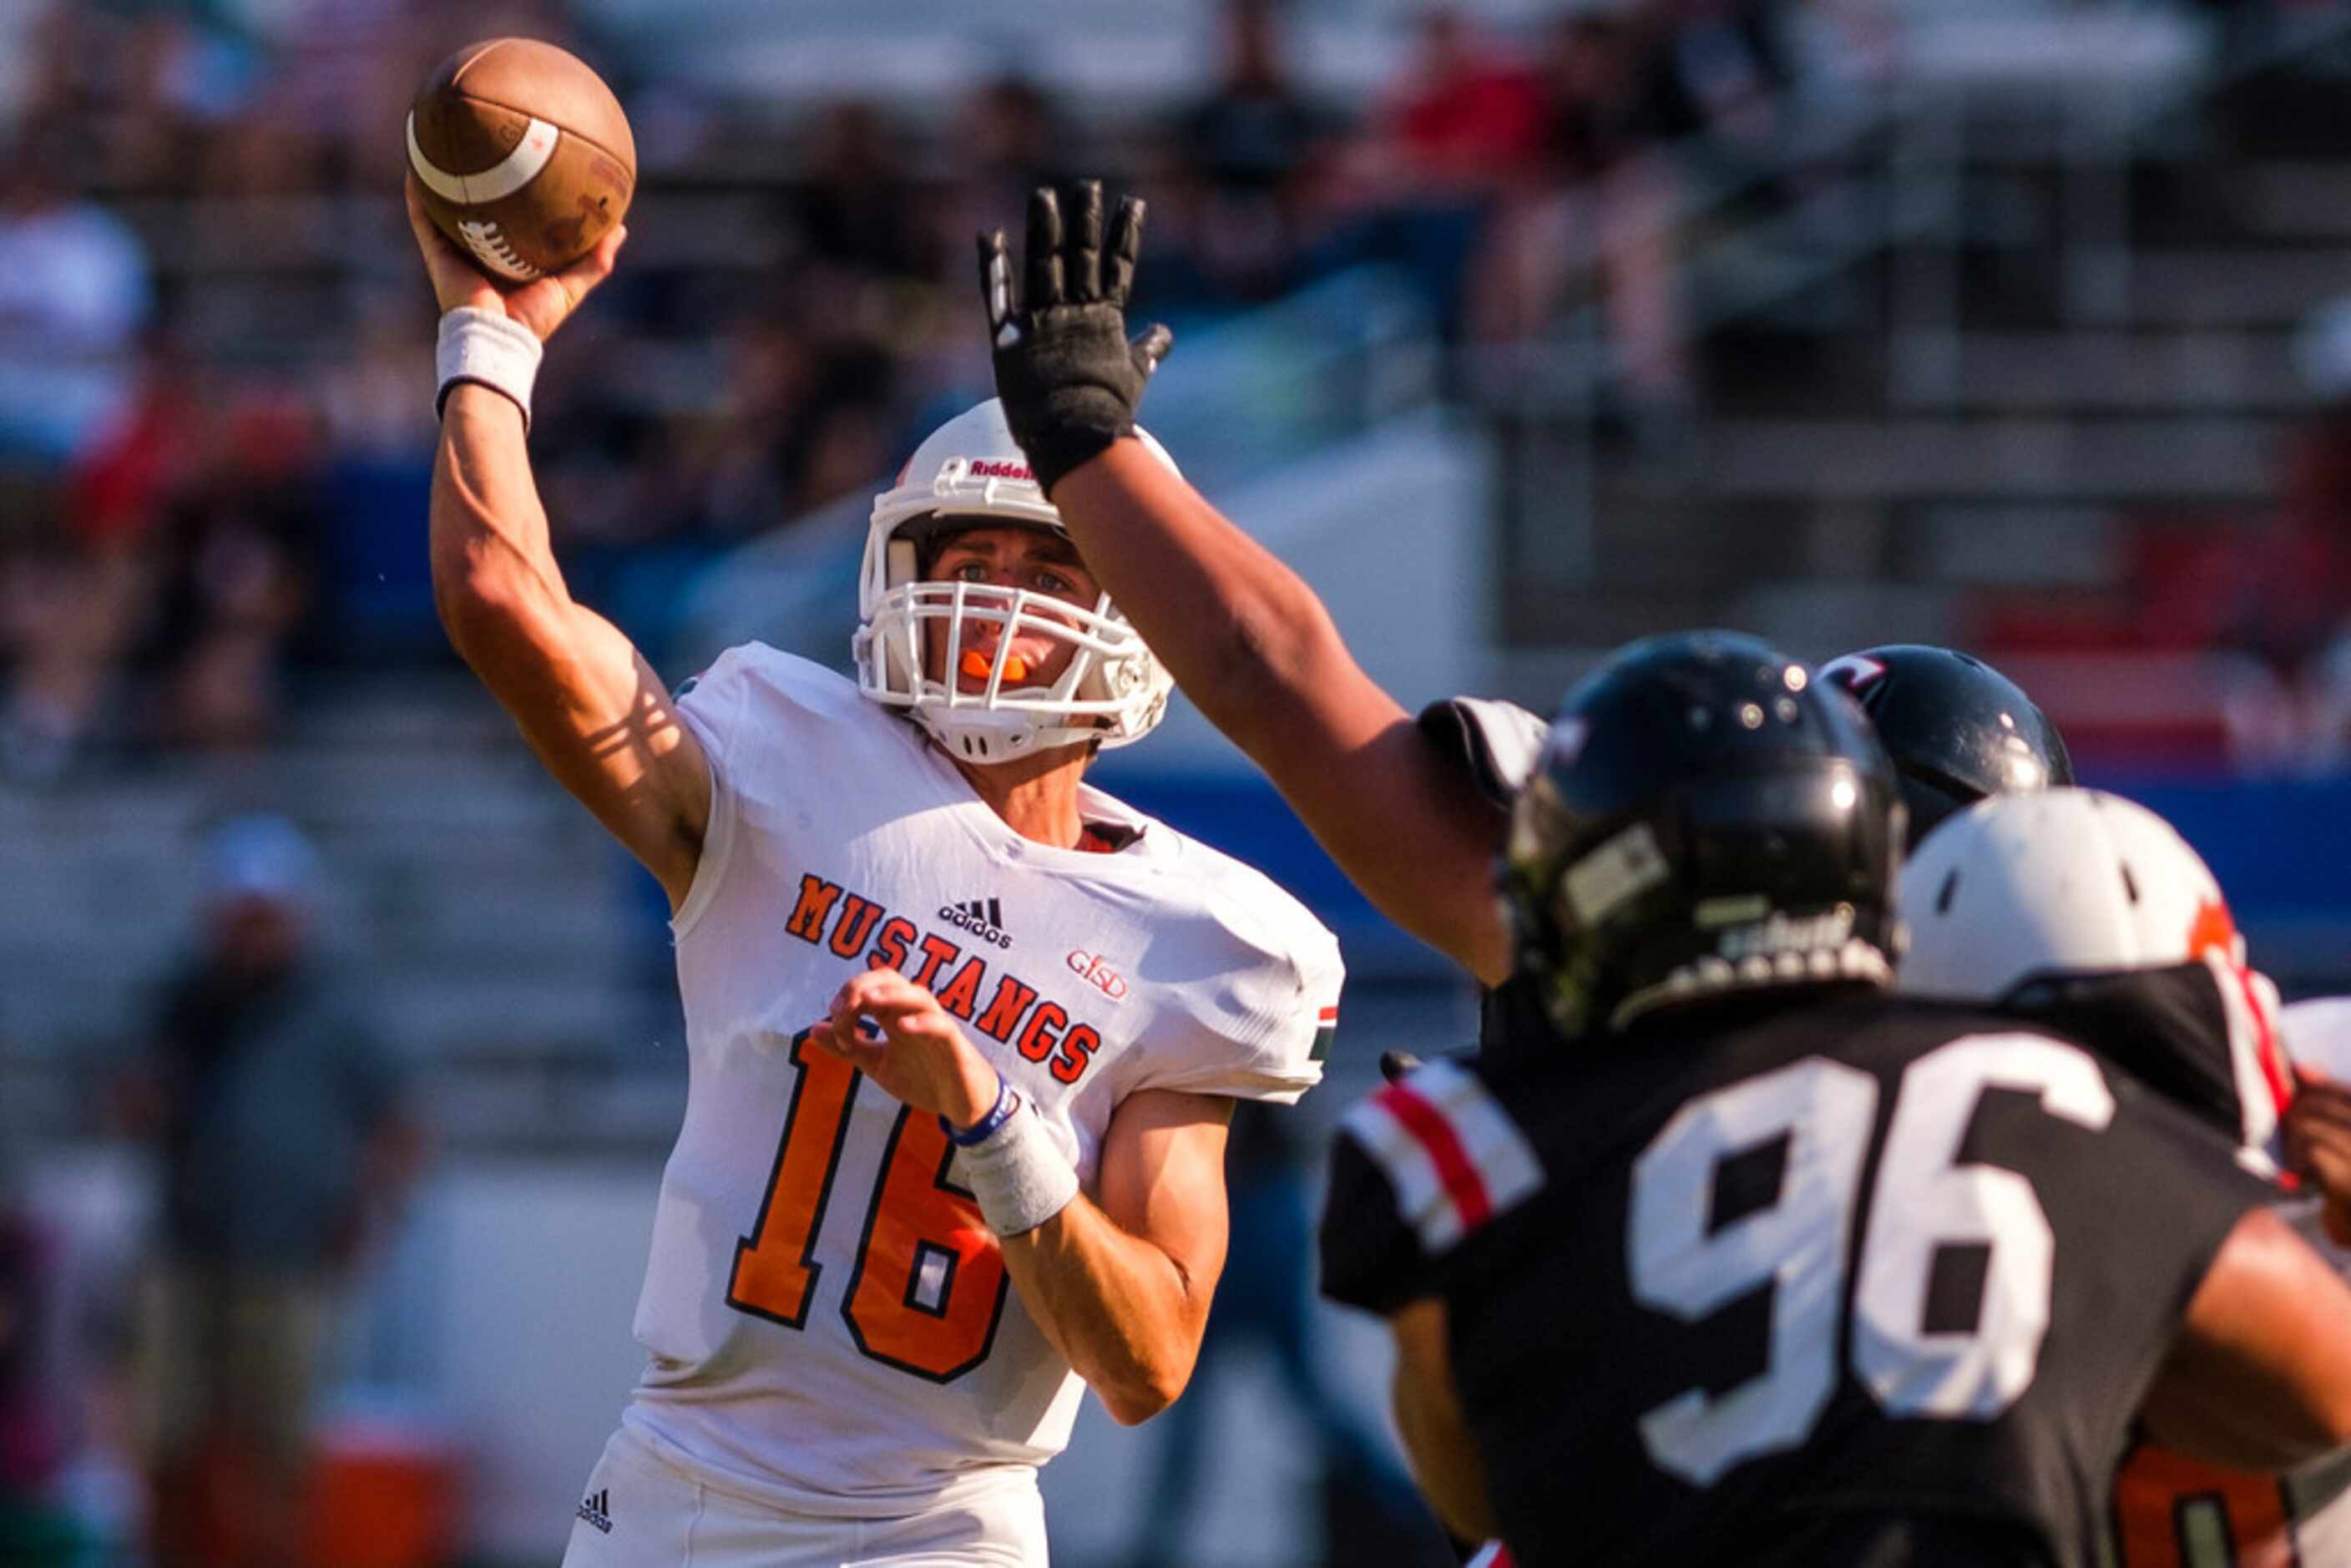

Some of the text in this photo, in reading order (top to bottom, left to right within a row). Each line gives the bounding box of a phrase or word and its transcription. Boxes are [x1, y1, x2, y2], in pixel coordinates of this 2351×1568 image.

[785, 873, 1101, 1085] MUSTANGS
[938, 905, 1013, 949] adidas
[726, 1015, 1010, 1385] 16
[1626, 1032, 2116, 1489] 96
